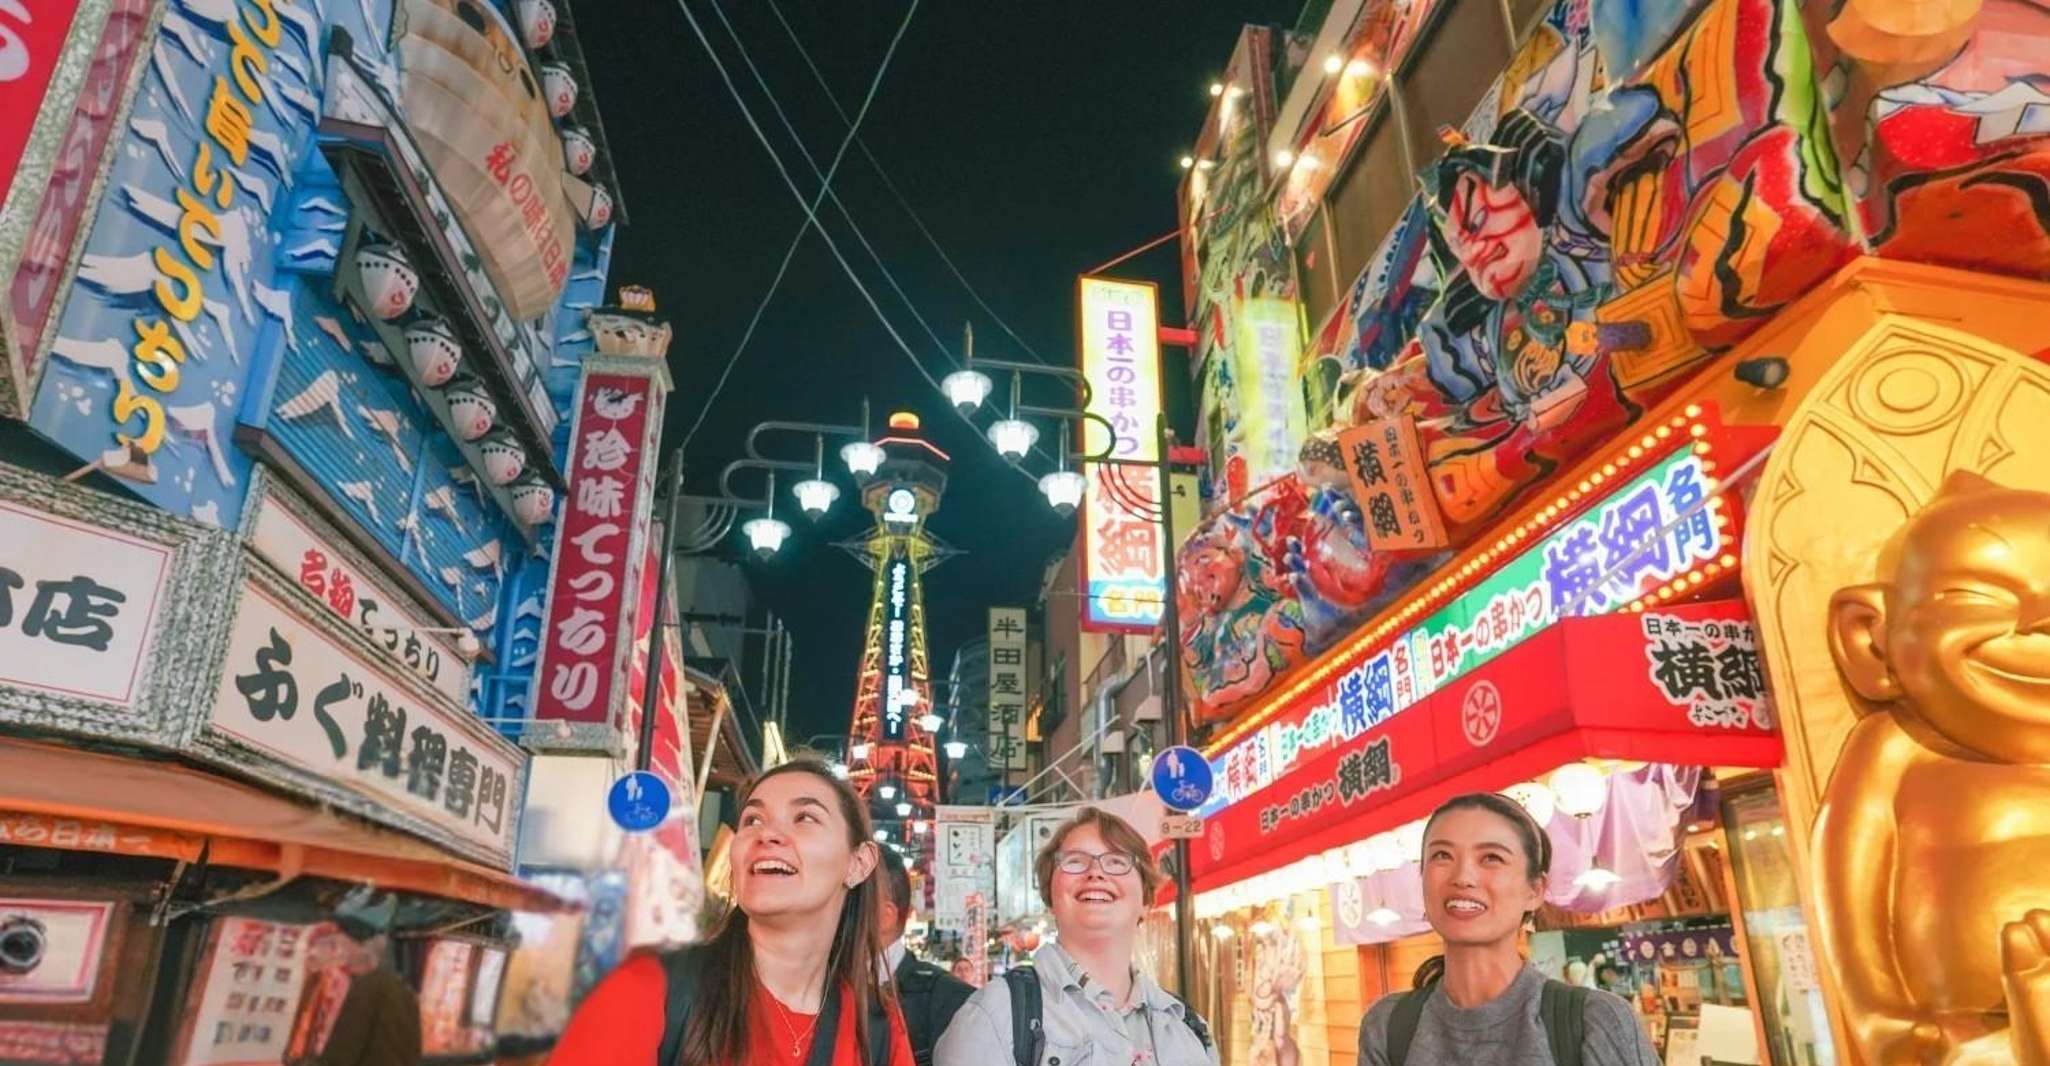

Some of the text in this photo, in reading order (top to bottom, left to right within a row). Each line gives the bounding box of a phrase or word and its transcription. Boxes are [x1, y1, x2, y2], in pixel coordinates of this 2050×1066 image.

[1106, 310, 1140, 455] 日本一の串かつ
[1352, 438, 1402, 539] 横綱
[1545, 485, 1669, 617] 横綱
[1666, 463, 1713, 564] 名門
[301, 549, 440, 682] 名物てっちり
[551, 428, 632, 711] 珍味てっちり
[1430, 587, 1544, 679] 日本一の串かつ
[236, 626, 506, 835] ふぐ料理専門
[992, 616, 1024, 759] 半田屋酒店
[1340, 654, 1394, 735] 横綱
[1339, 738, 1391, 801] 横綱
